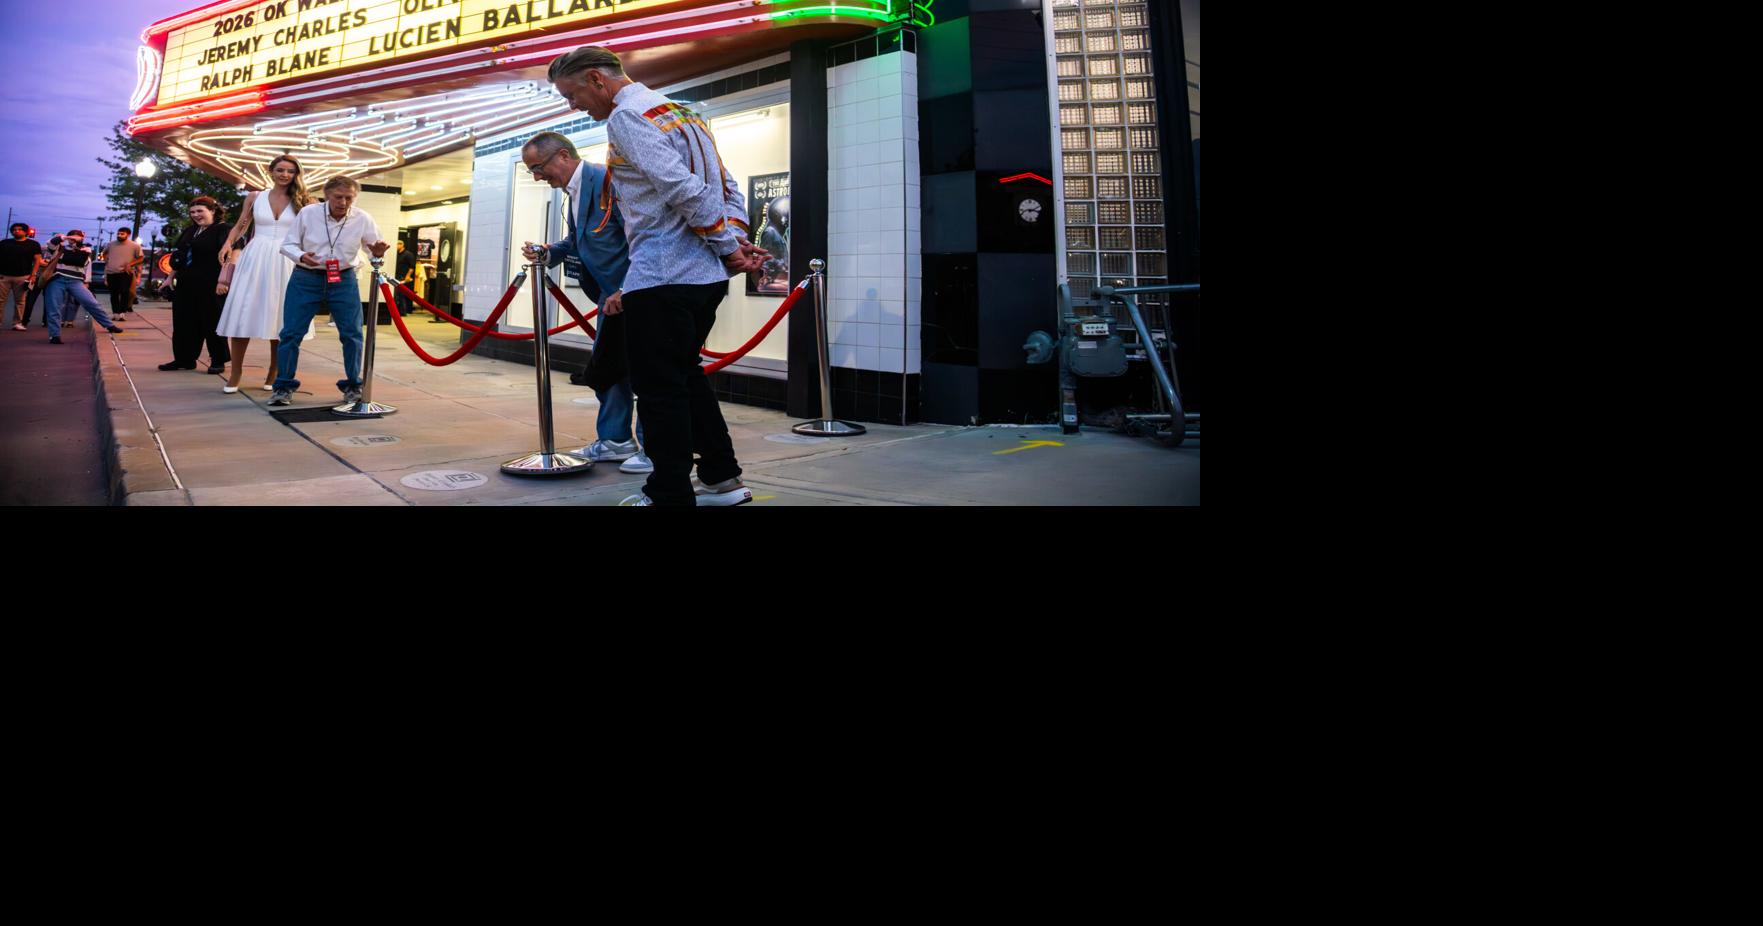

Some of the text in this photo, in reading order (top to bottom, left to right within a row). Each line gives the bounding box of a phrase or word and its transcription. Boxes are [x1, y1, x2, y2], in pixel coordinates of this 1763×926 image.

[197, 34, 263, 66] JEREMY
[274, 8, 367, 46] CHARLES
[213, 11, 255, 37] 2026
[264, 0, 288, 21] OK
[200, 64, 253, 91] RALPH
[266, 47, 331, 77] BLANE
[369, 16, 462, 56] LUCIEN
